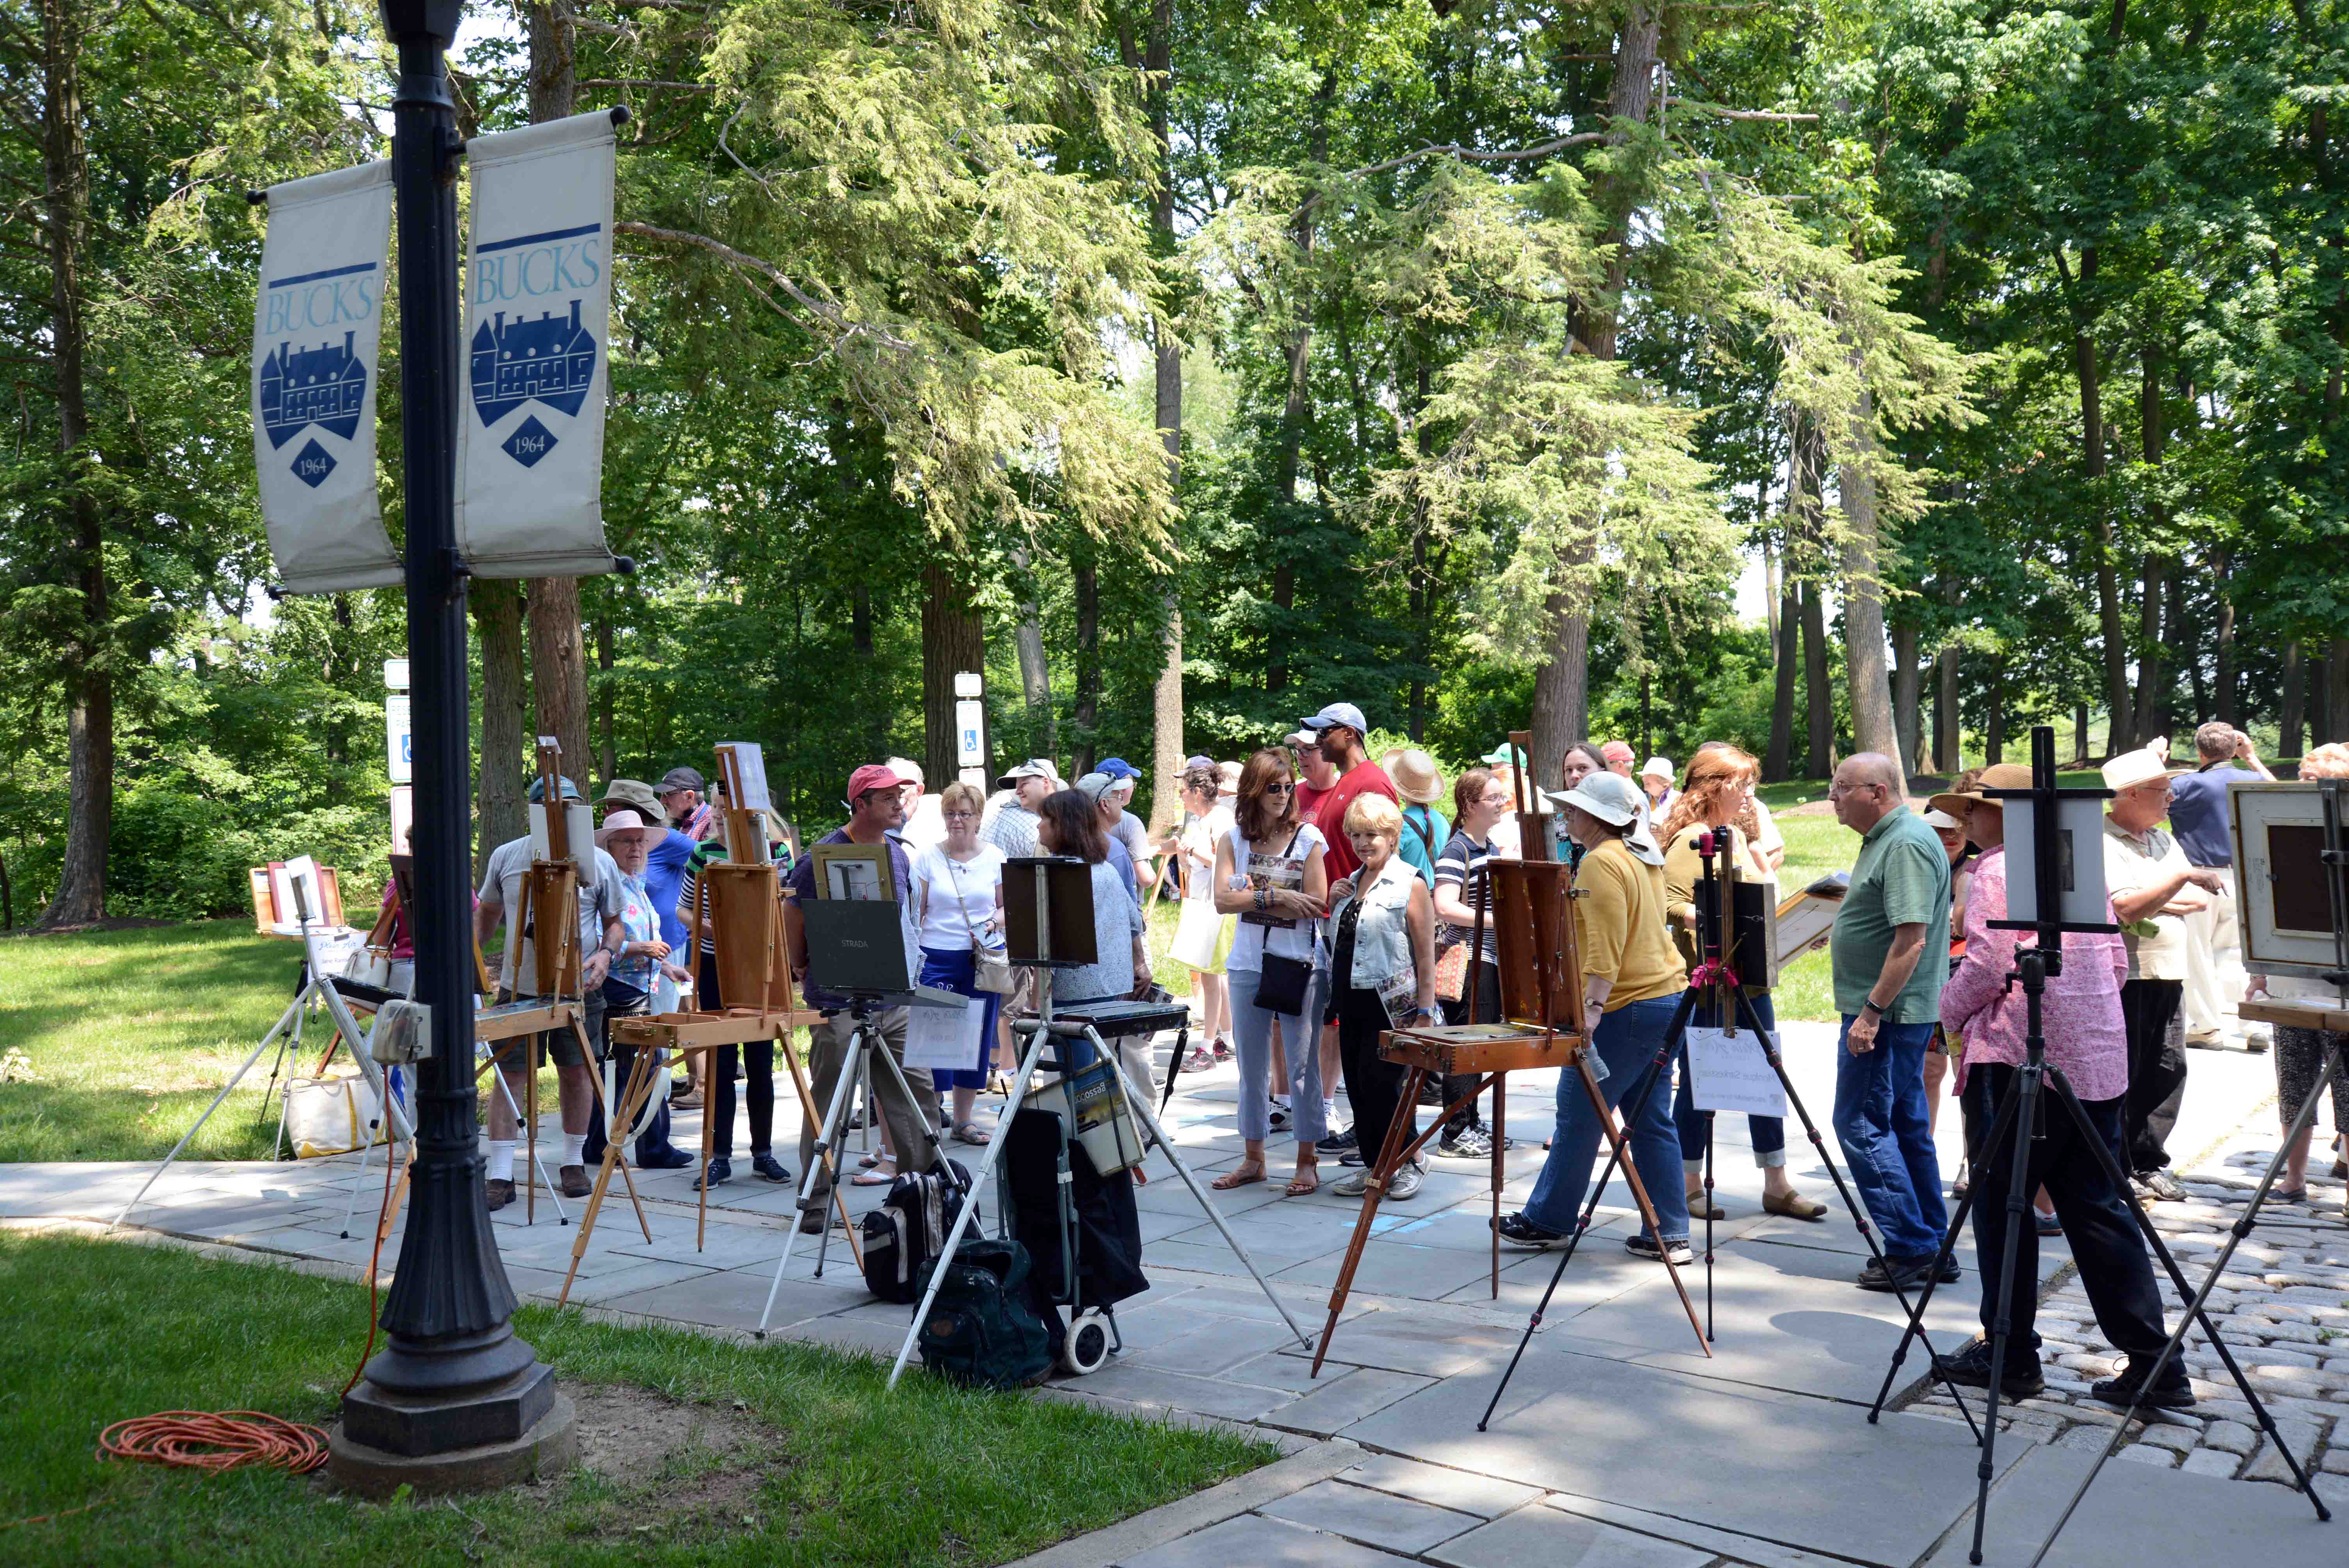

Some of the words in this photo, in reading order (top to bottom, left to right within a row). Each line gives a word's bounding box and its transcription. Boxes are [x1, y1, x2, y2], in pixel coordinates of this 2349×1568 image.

[476, 239, 599, 305] BUCKS
[266, 276, 374, 334] BUCKS
[515, 436, 544, 455] 1964
[300, 458, 327, 475] 1964
[1074, 1082, 1106, 1103] gessobo
